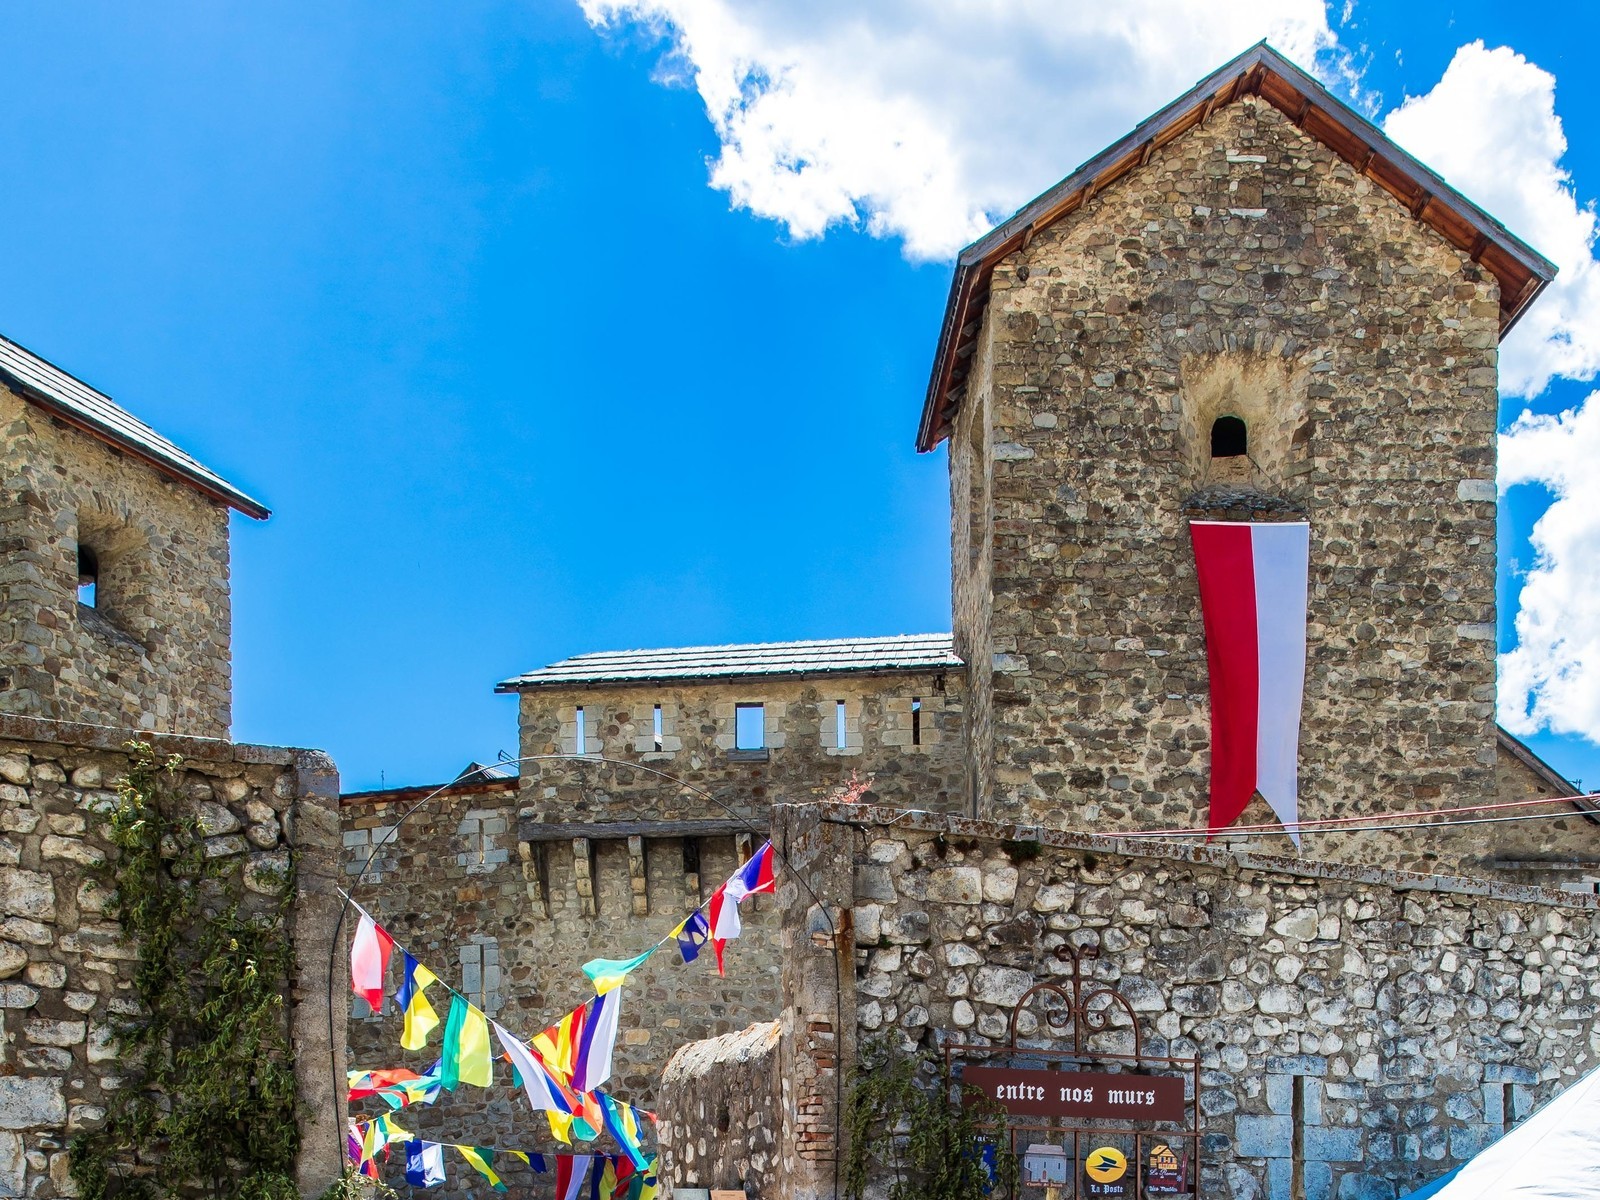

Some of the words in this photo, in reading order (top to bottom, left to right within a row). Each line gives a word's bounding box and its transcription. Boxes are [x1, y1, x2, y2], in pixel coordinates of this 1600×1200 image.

[996, 1081, 1045, 1101] entre
[1060, 1086, 1094, 1102] nos
[1108, 1089, 1155, 1105] murs
[1091, 1185, 1100, 1193] La
[1103, 1184, 1123, 1194] Poste
